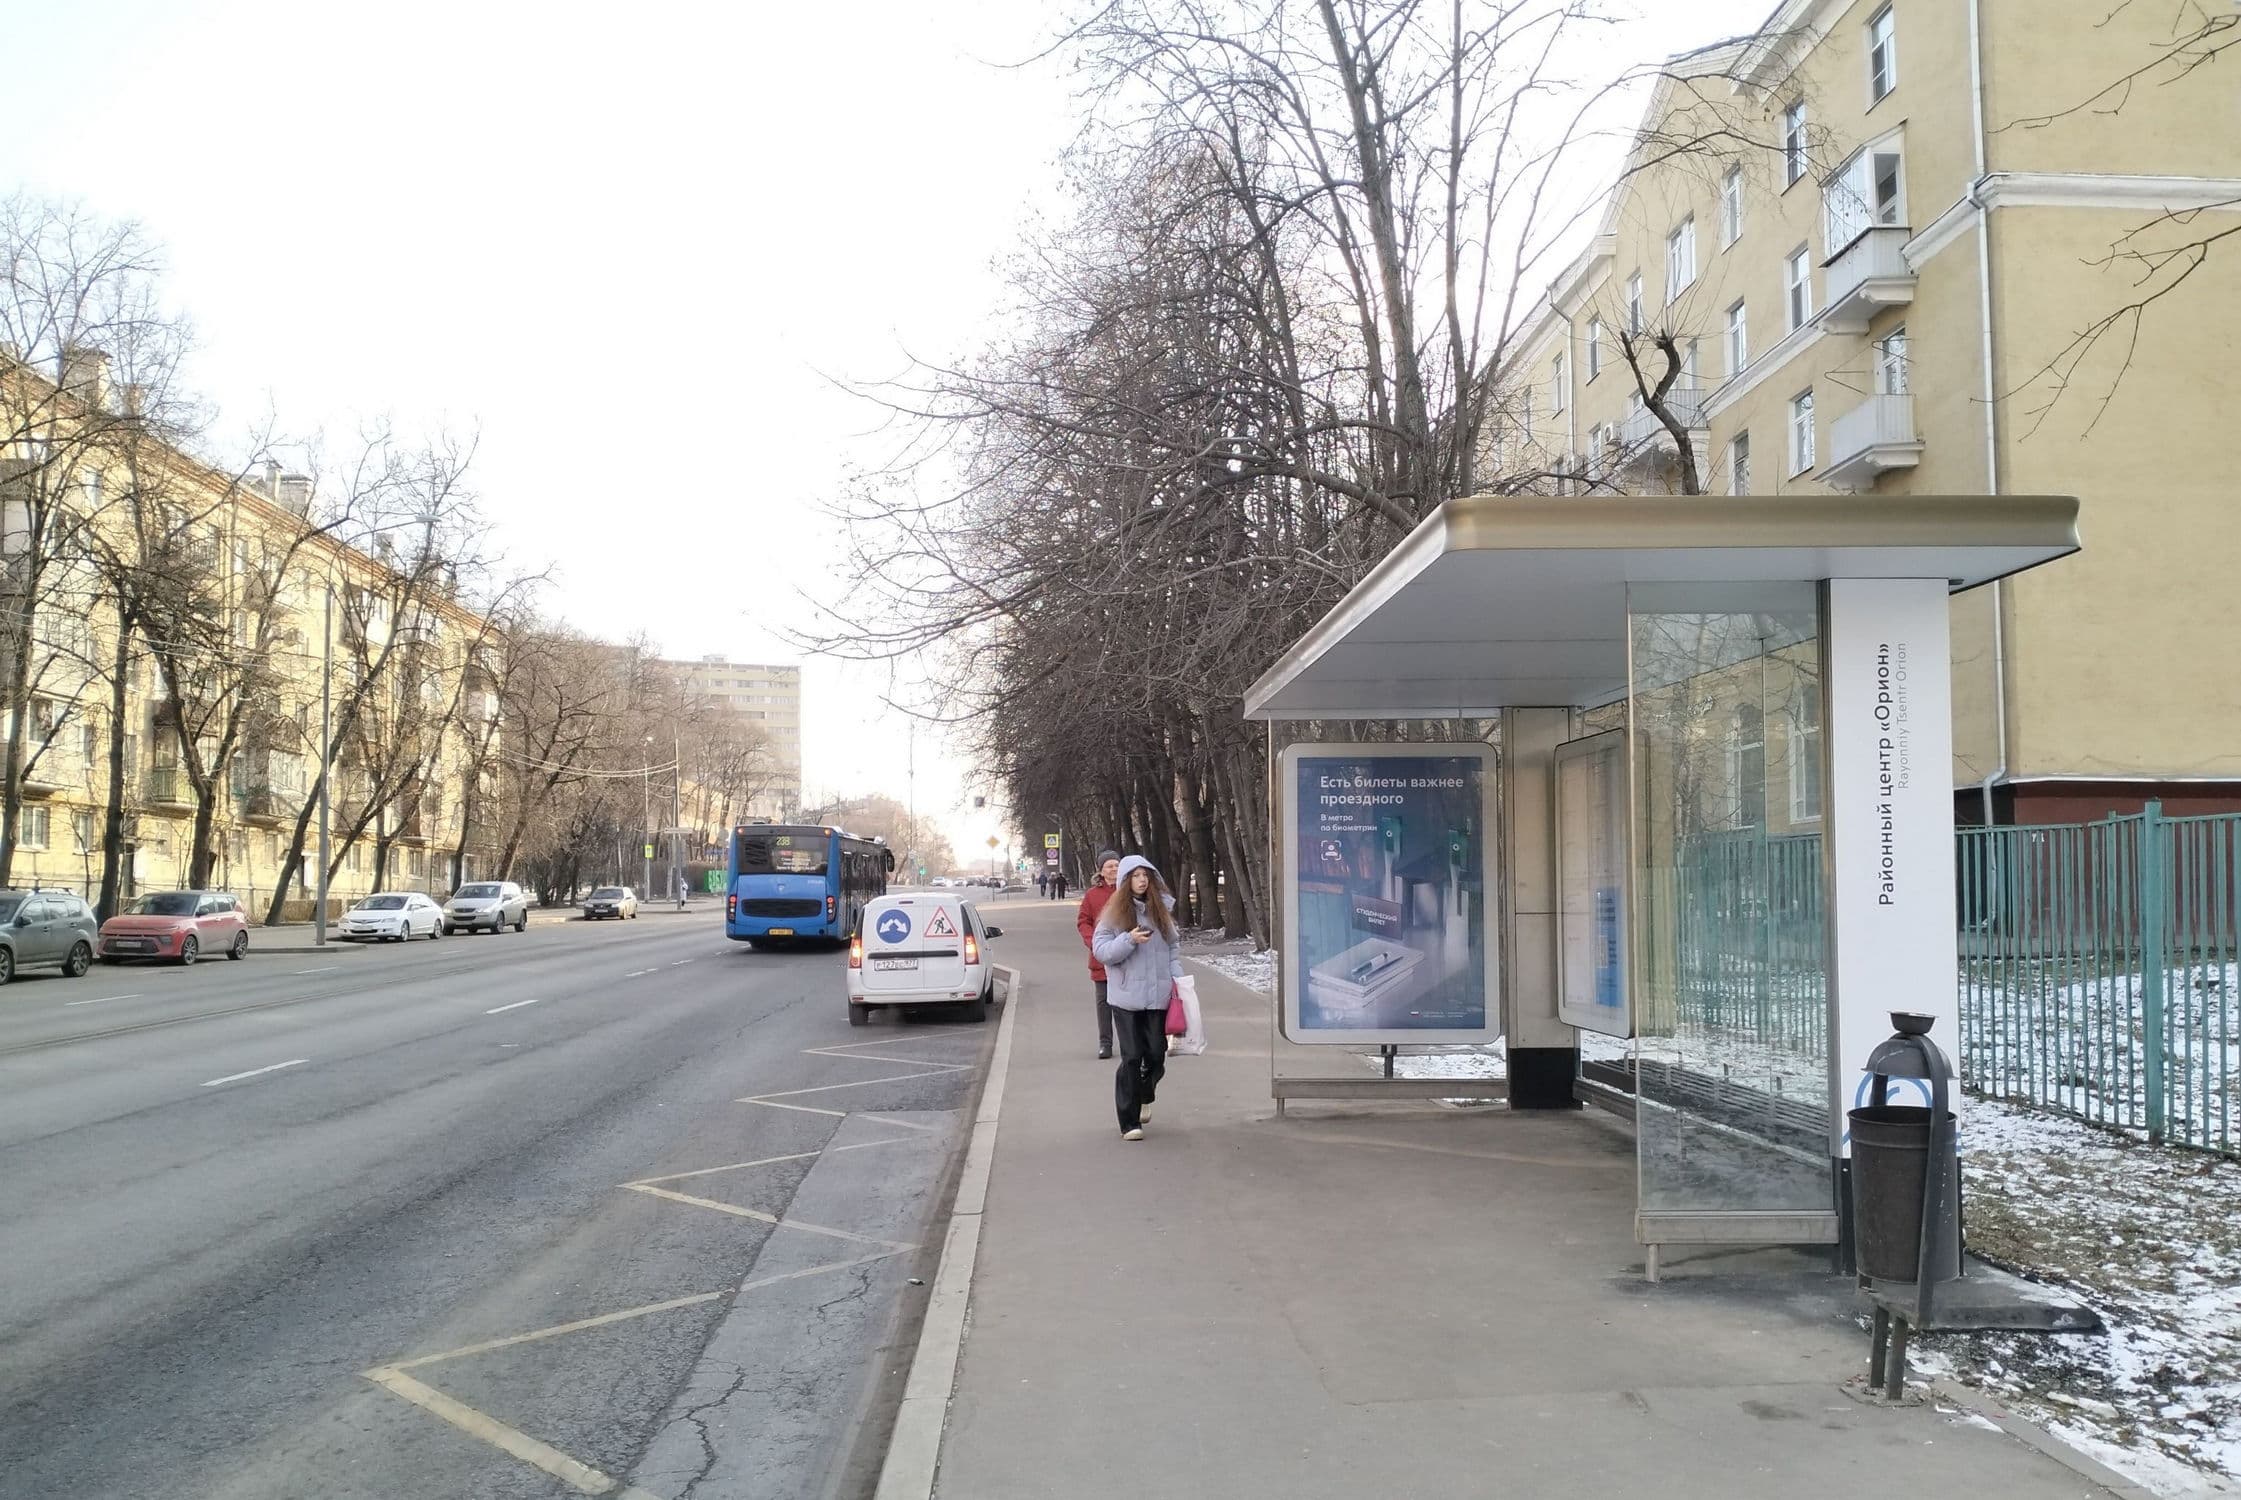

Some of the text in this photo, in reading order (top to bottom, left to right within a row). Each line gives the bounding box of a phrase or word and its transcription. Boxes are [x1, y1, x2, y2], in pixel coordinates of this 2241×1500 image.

[1895, 643, 1911, 789] Rayonniy Tsentr Orion
[1874, 643, 1895, 905] Районный центр «Орион»
[1320, 775, 1464, 788] Есть билеты важнее
[1320, 795, 1404, 807] проездного
[1320, 813, 1327, 821] В
[1332, 823, 1378, 832] биометрии
